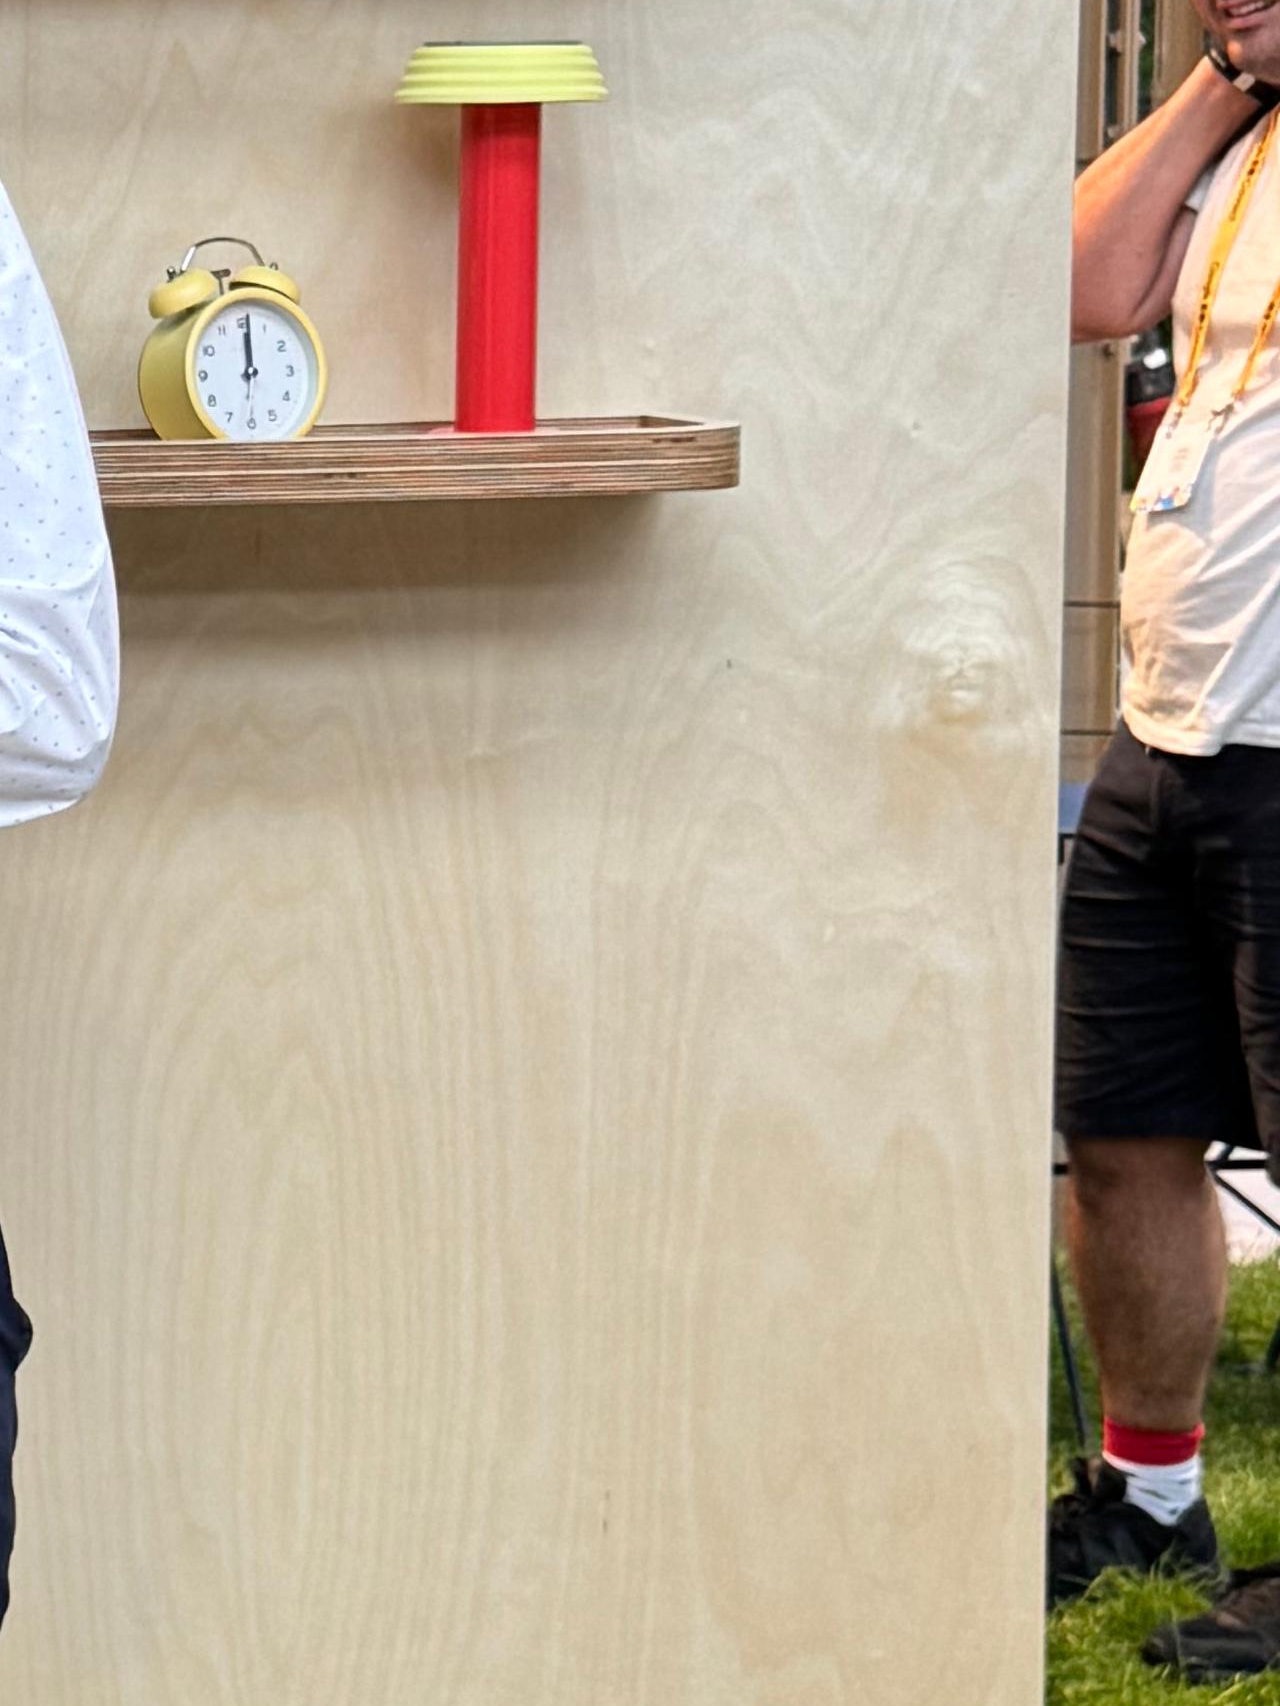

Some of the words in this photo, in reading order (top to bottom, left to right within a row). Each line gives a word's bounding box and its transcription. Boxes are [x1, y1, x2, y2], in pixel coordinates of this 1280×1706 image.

[202, 345, 216, 357] 10
[276, 340, 287, 353] 2
[198, 369, 209, 382] 9
[285, 364, 295, 377] 3
[207, 393, 217, 408] 8
[282, 390, 291, 402] 4
[225, 411, 234, 423] 7
[267, 409, 278, 422] 5
[246, 417, 257, 430] 6
